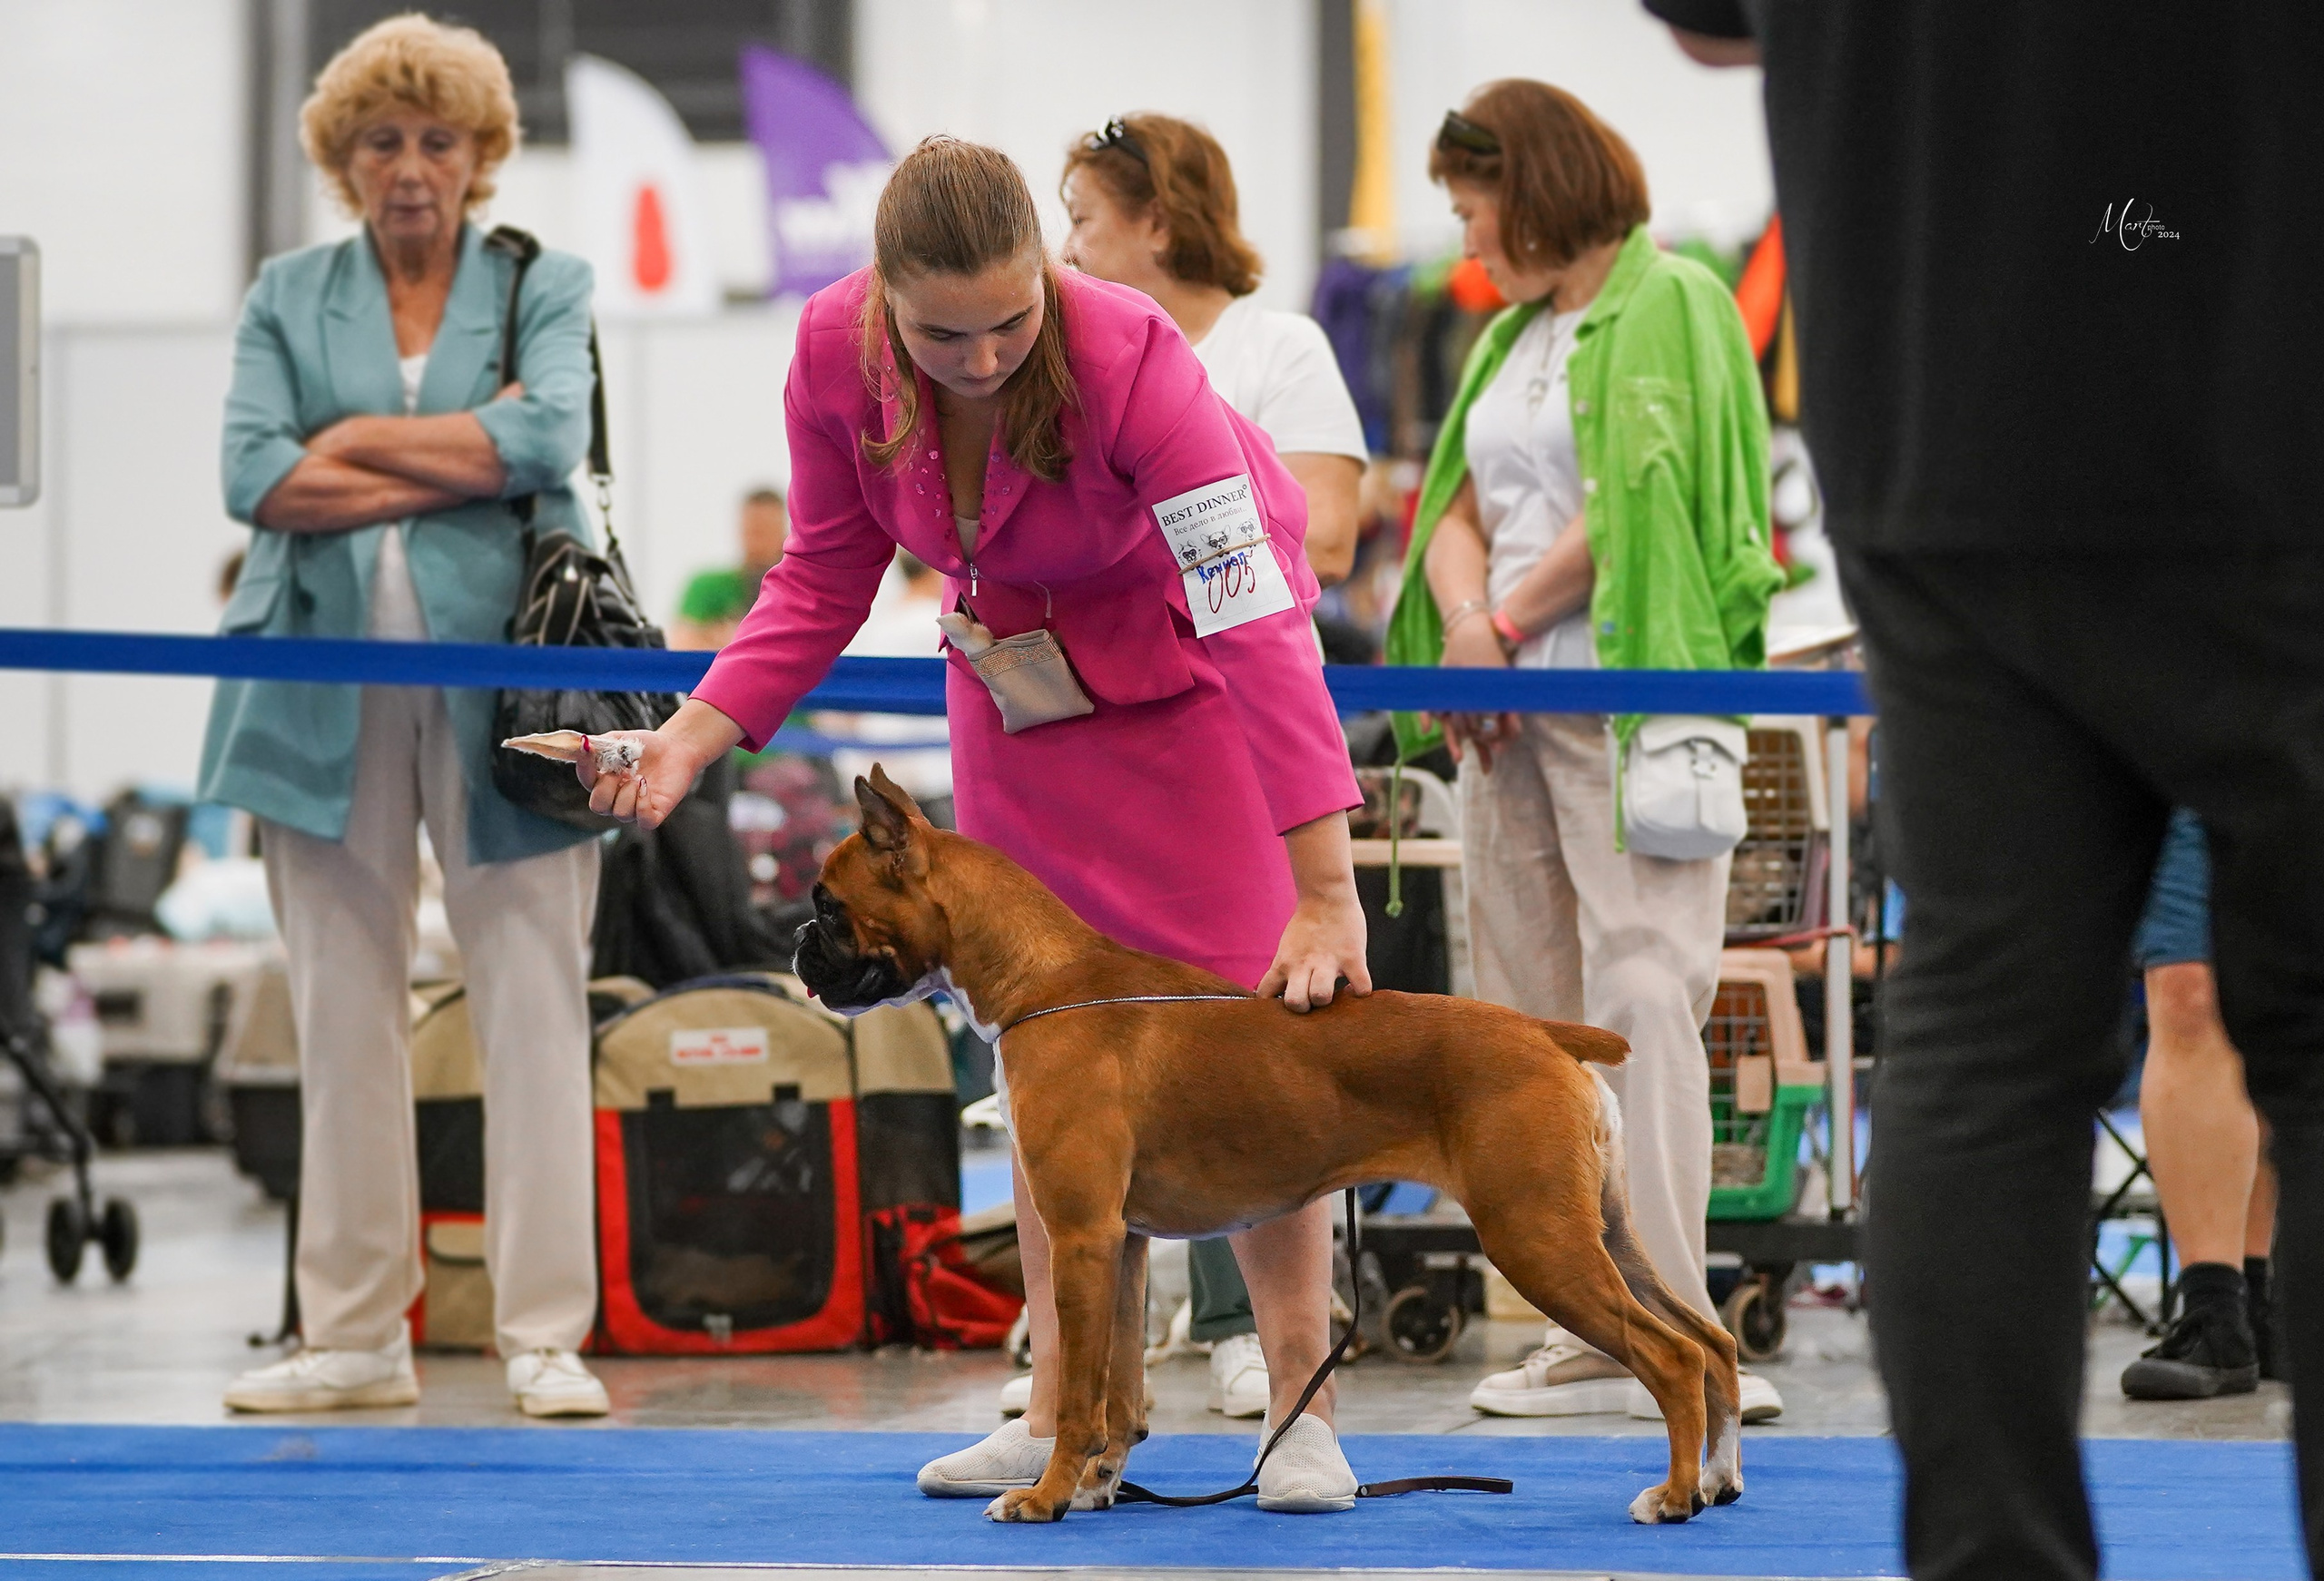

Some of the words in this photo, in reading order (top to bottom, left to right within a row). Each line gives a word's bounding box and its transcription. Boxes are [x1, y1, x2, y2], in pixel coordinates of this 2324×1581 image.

[1162, 506, 1193, 526] BEST
[1174, 525, 1187, 535] Все
[1190, 518, 1208, 531] дело
[1208, 550, 1255, 614] 005
